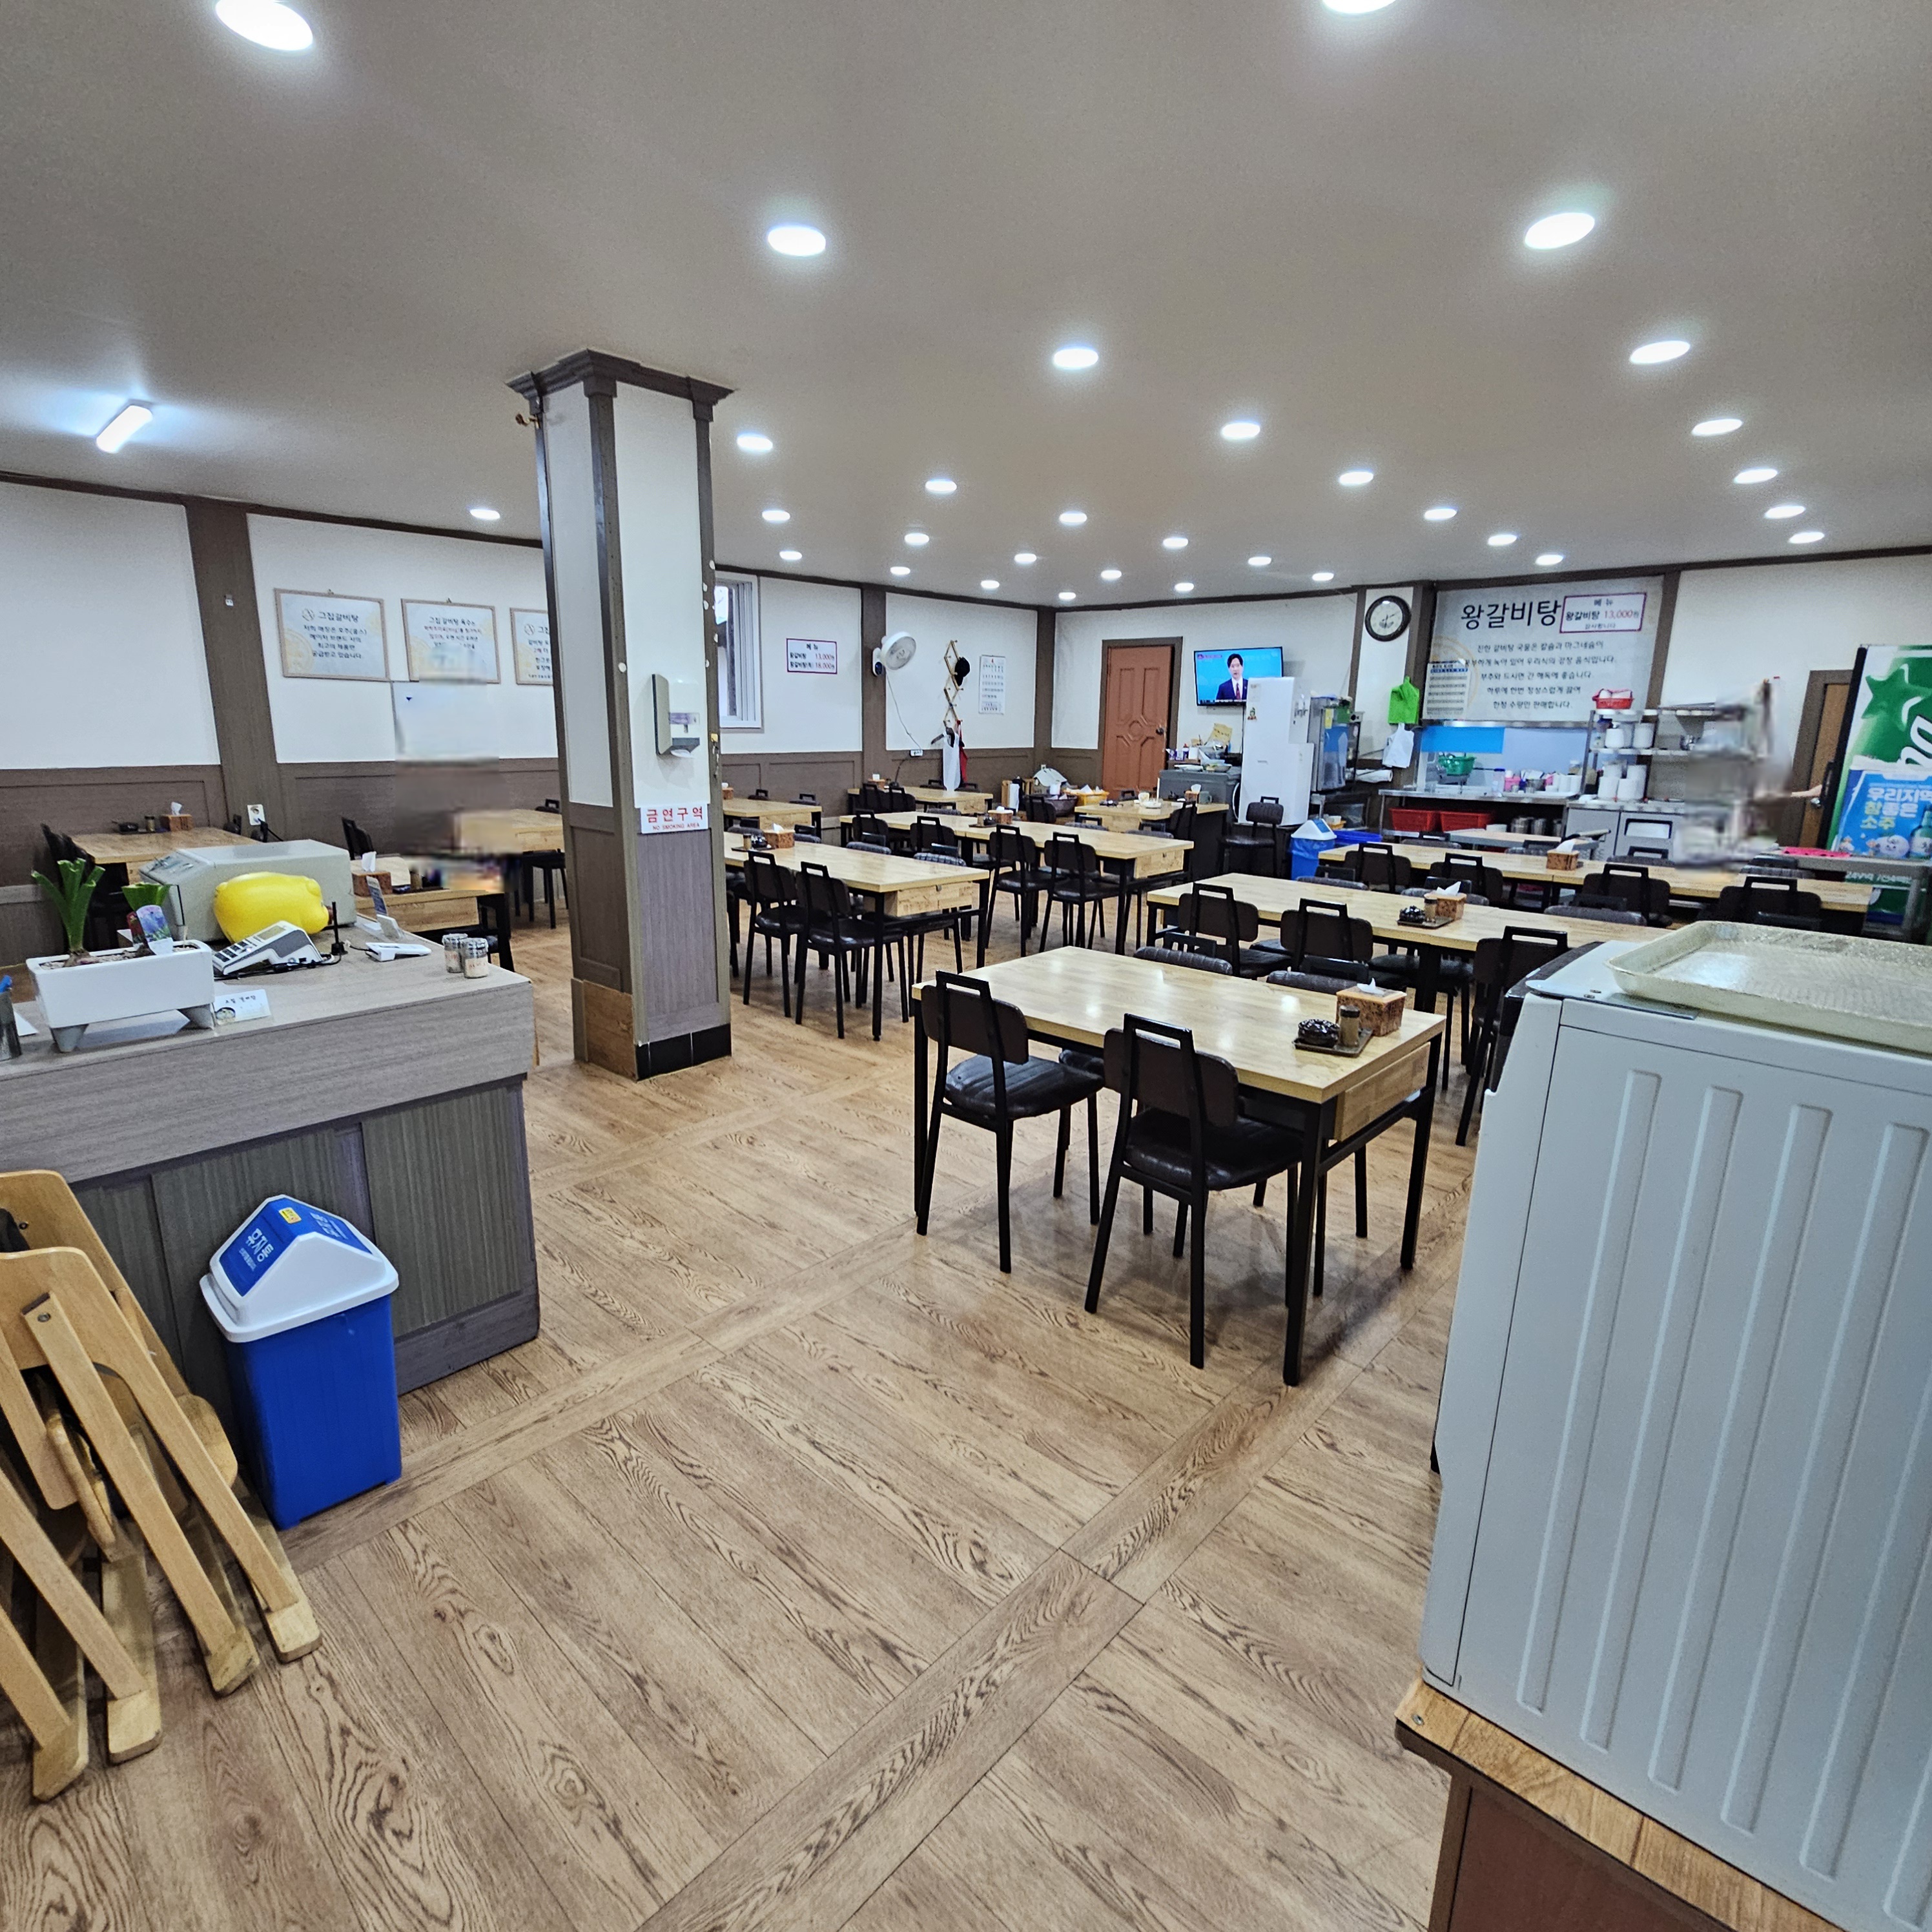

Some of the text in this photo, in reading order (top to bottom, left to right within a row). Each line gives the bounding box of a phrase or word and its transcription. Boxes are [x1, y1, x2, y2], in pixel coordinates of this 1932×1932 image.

[1461, 599, 1562, 630] 왕갈비탕
[1565, 610, 1600, 621] 왕갈비탕
[1477, 640, 1604, 653] 진한 갈비탕 국물은 칼슘과 마그네슘이
[1494, 658, 1508, 666] 녹아
[1510, 658, 1524, 666] 있어
[1481, 672, 1501, 681] 부추와
[1504, 672, 1525, 681] 드시면
[1527, 672, 1535, 680] 간
[1537, 672, 1559, 680] 해독에
[1487, 686, 1581, 695] 하루에 한번 정성스럽게 끓여
[1493, 701, 1507, 710] 한정
[1510, 701, 1531, 710] 수량만
[646, 806, 703, 823] 금연구역
[1860, 815, 1896, 830] 소주
[245, 1228, 274, 1262] 휴지통
